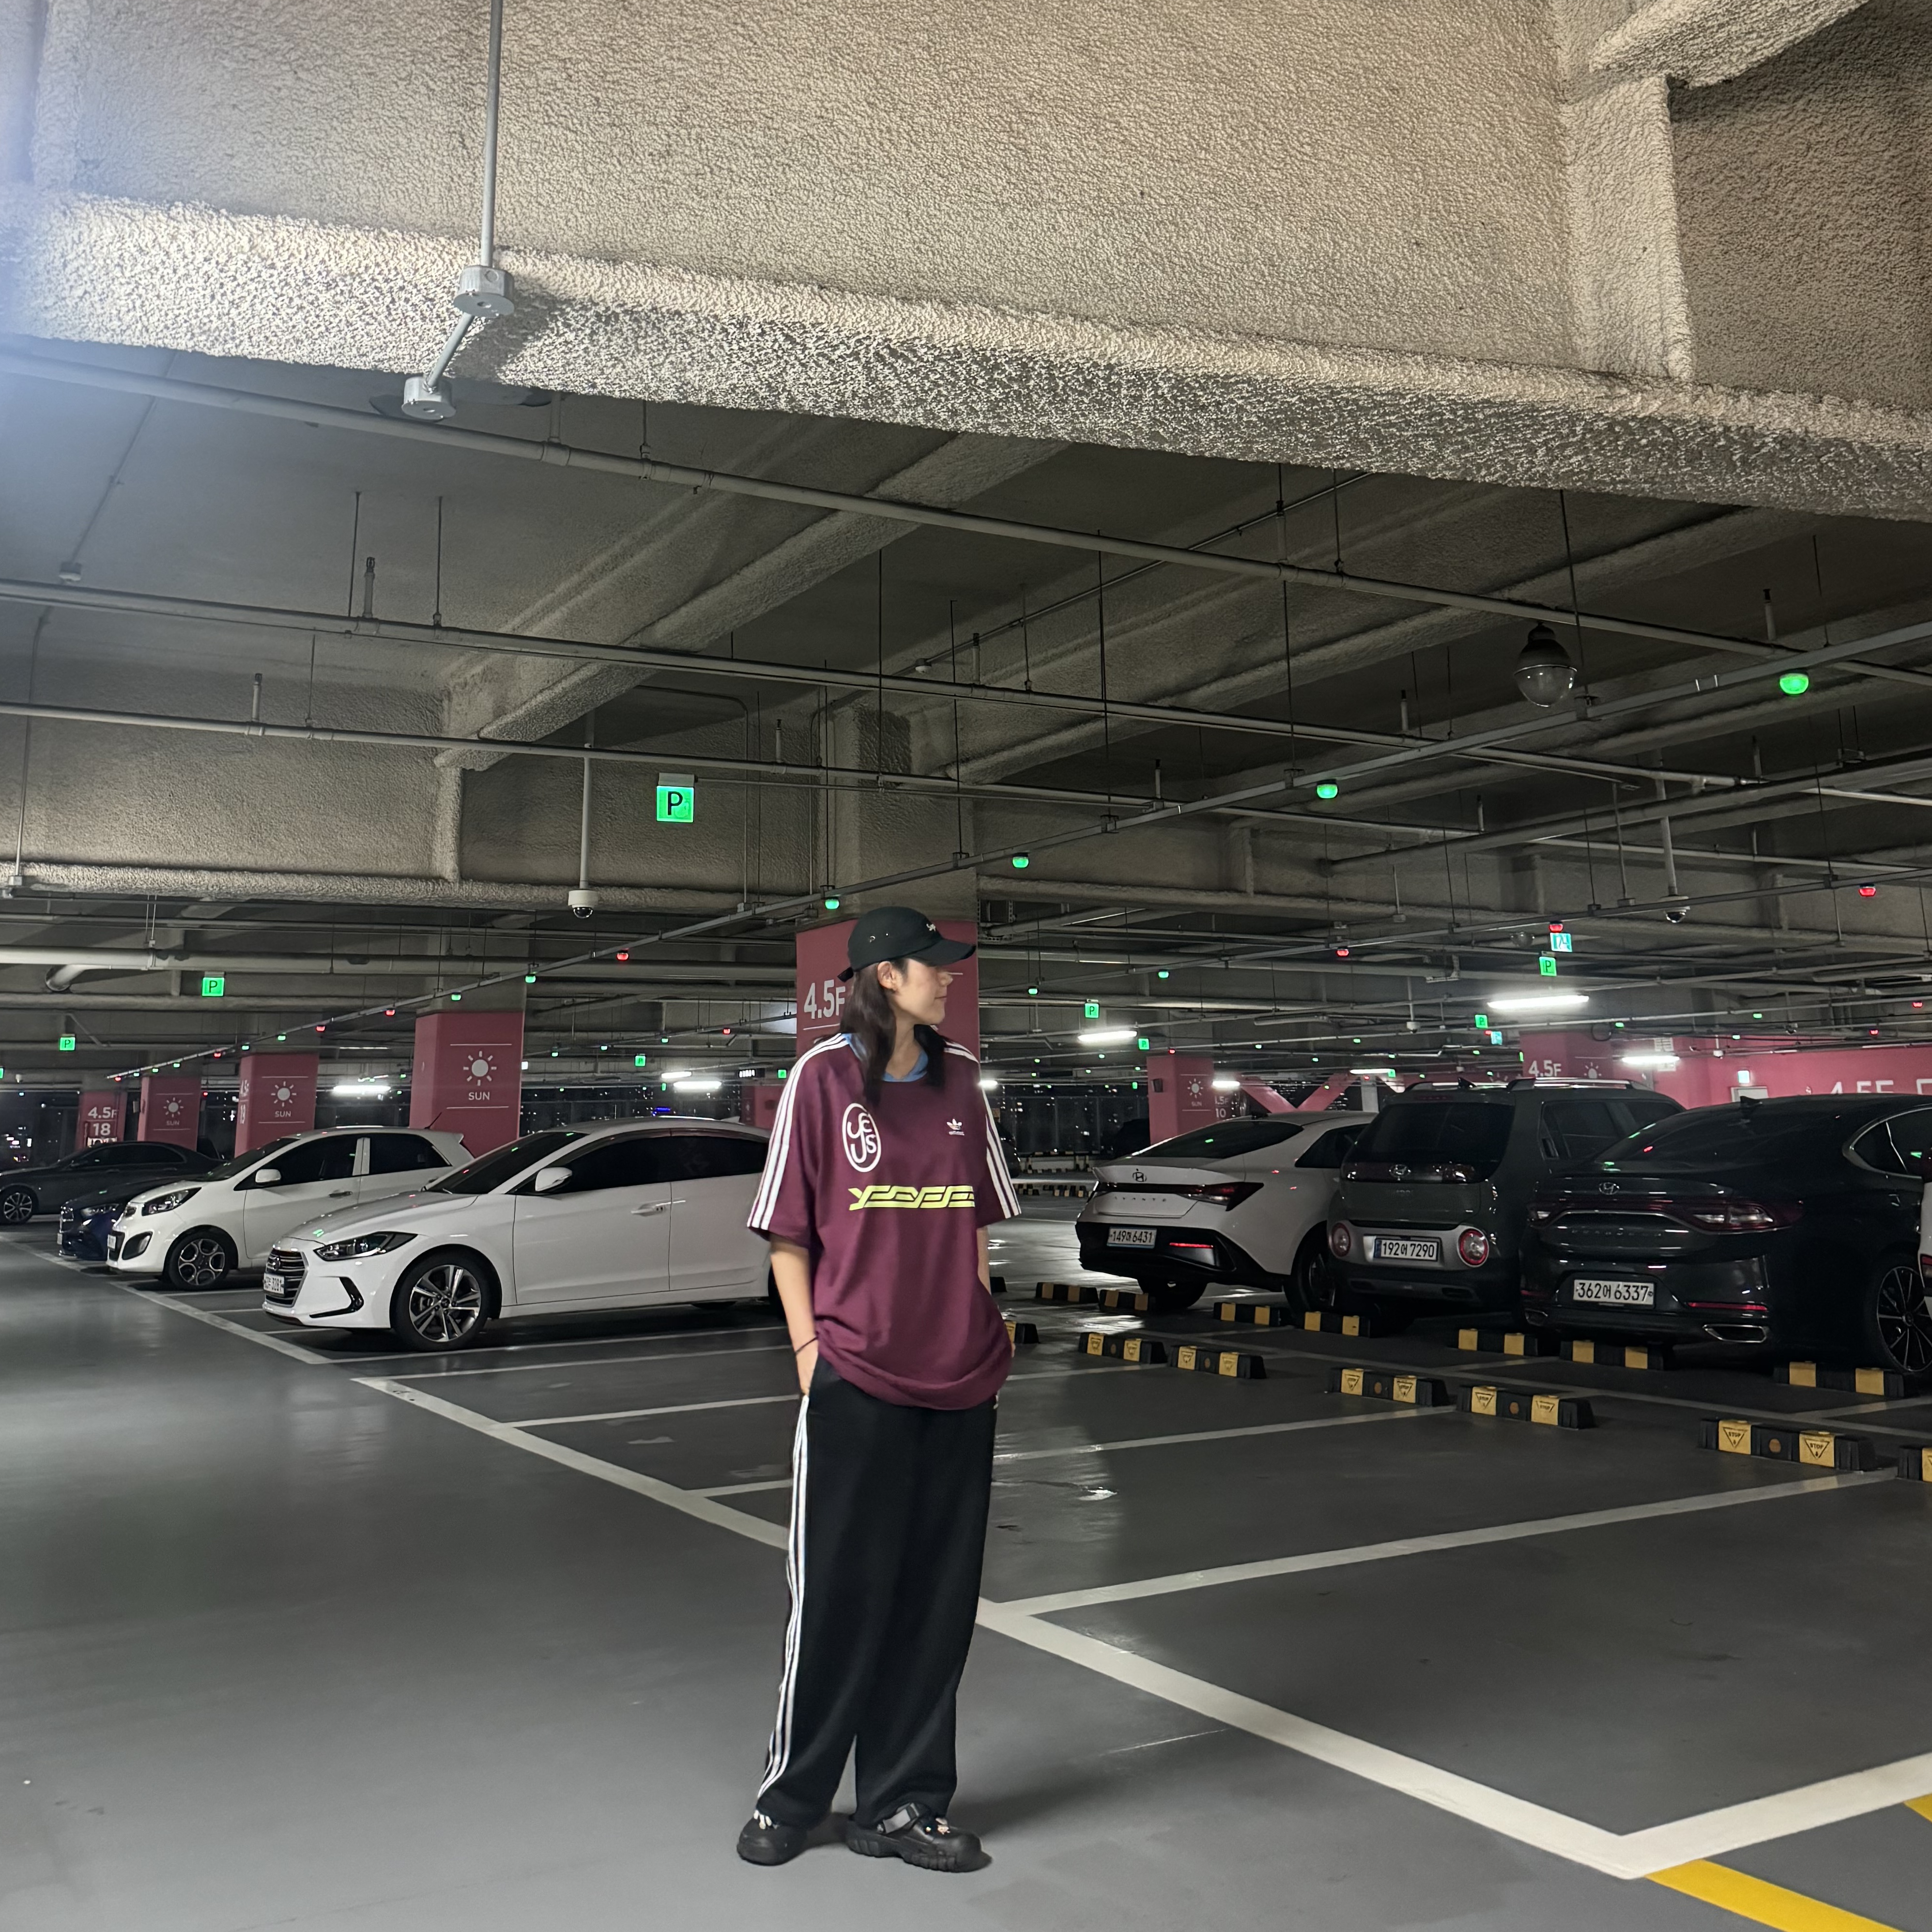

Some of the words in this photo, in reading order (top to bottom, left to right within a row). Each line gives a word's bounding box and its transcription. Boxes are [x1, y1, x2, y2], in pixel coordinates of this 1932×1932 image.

[667, 791, 683, 816] P
[1545, 960, 1552, 972] P
[209, 980, 218, 993] P
[803, 979, 846, 1019] 4.5F
[1089, 1006, 1095, 1015] P
[64, 1039, 71, 1048] P
[1528, 1059, 1562, 1077] 4.5F
[468, 1091, 490, 1101] SUN
[93, 1122, 111, 1136] 18
[1410, 1243, 1435, 1258] 7290
[1614, 1284, 1649, 1302] 6337
